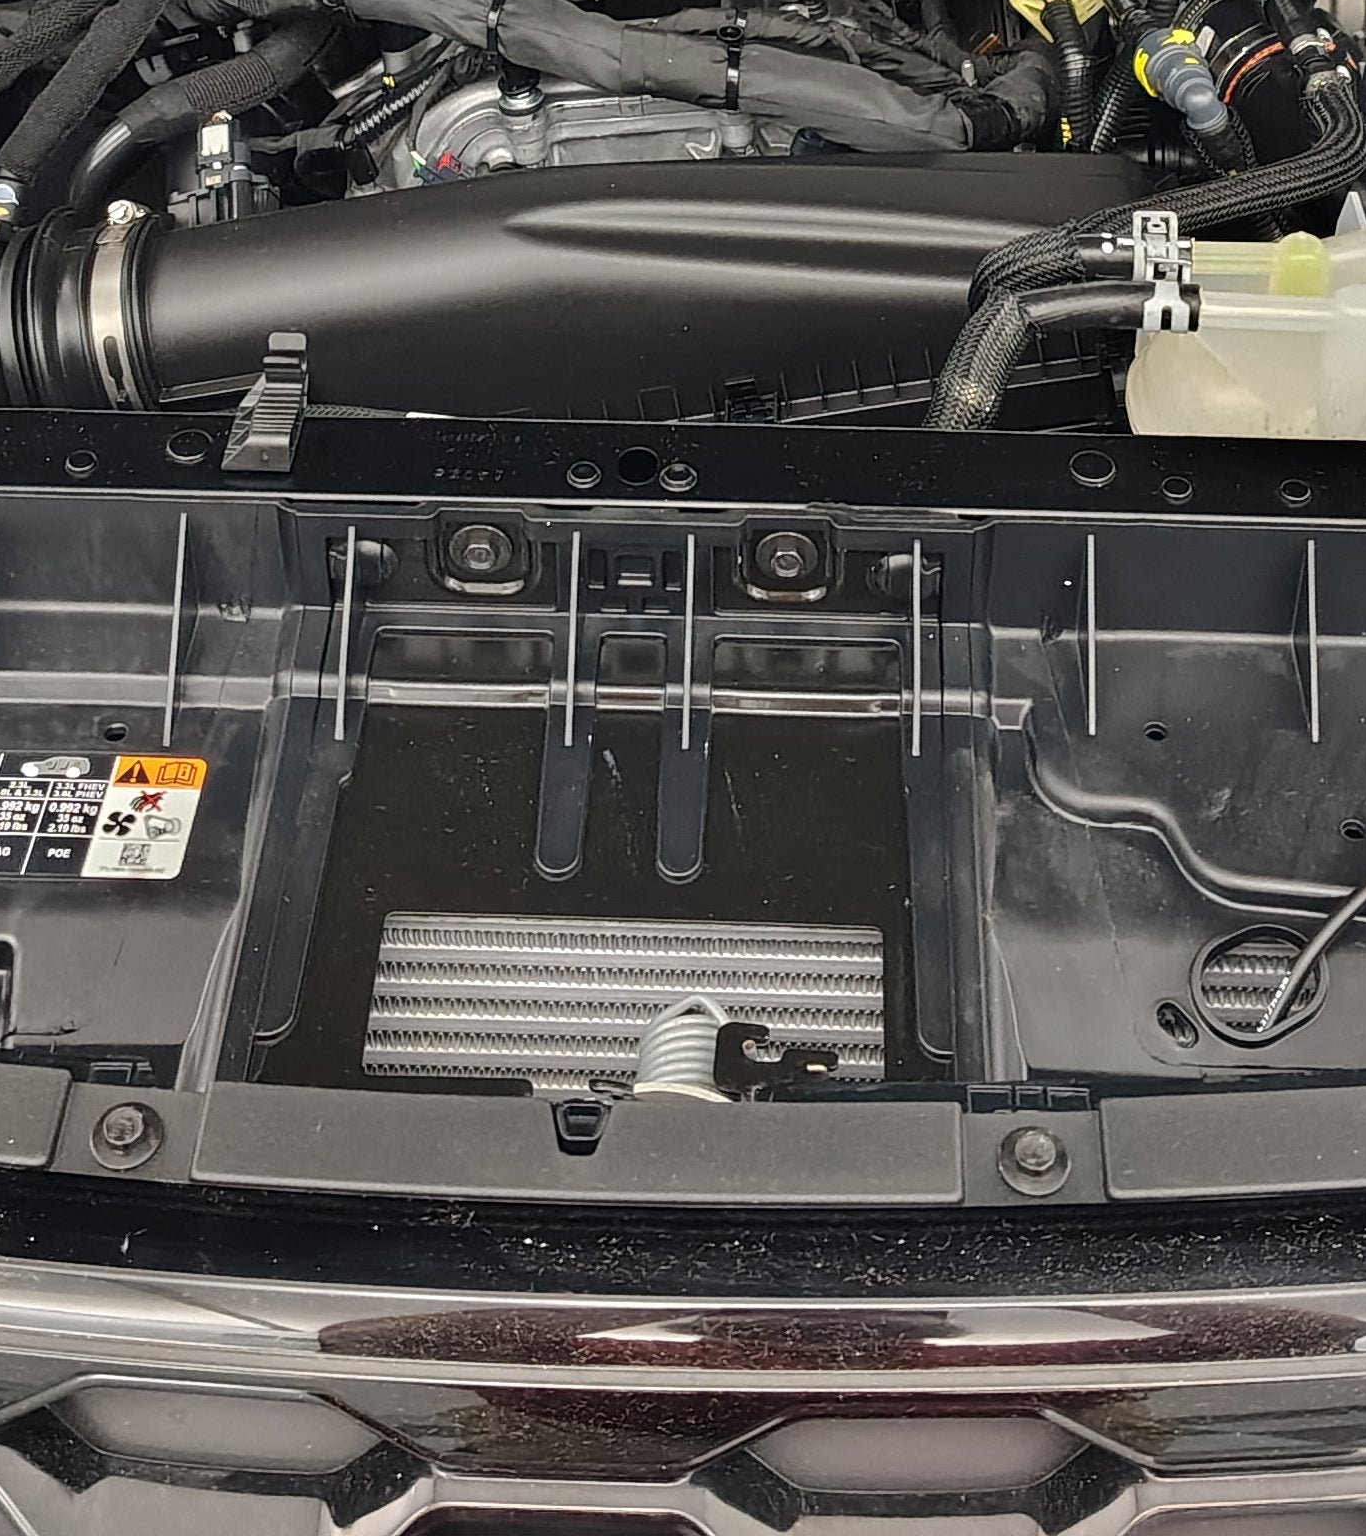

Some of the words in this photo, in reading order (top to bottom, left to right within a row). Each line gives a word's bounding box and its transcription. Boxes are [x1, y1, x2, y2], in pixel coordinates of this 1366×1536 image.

[23, 801, 40, 814] kg
[48, 802, 82, 813] 0.992
[81, 803, 98, 816] kg
[13, 813, 27, 821] oz
[55, 814, 70, 823] 35
[70, 815, 84, 823] oz
[11, 821, 28, 831] lbs
[47, 823, 70, 832] 2.19
[70, 823, 87, 833] lbs
[47, 847, 72, 858] POE
